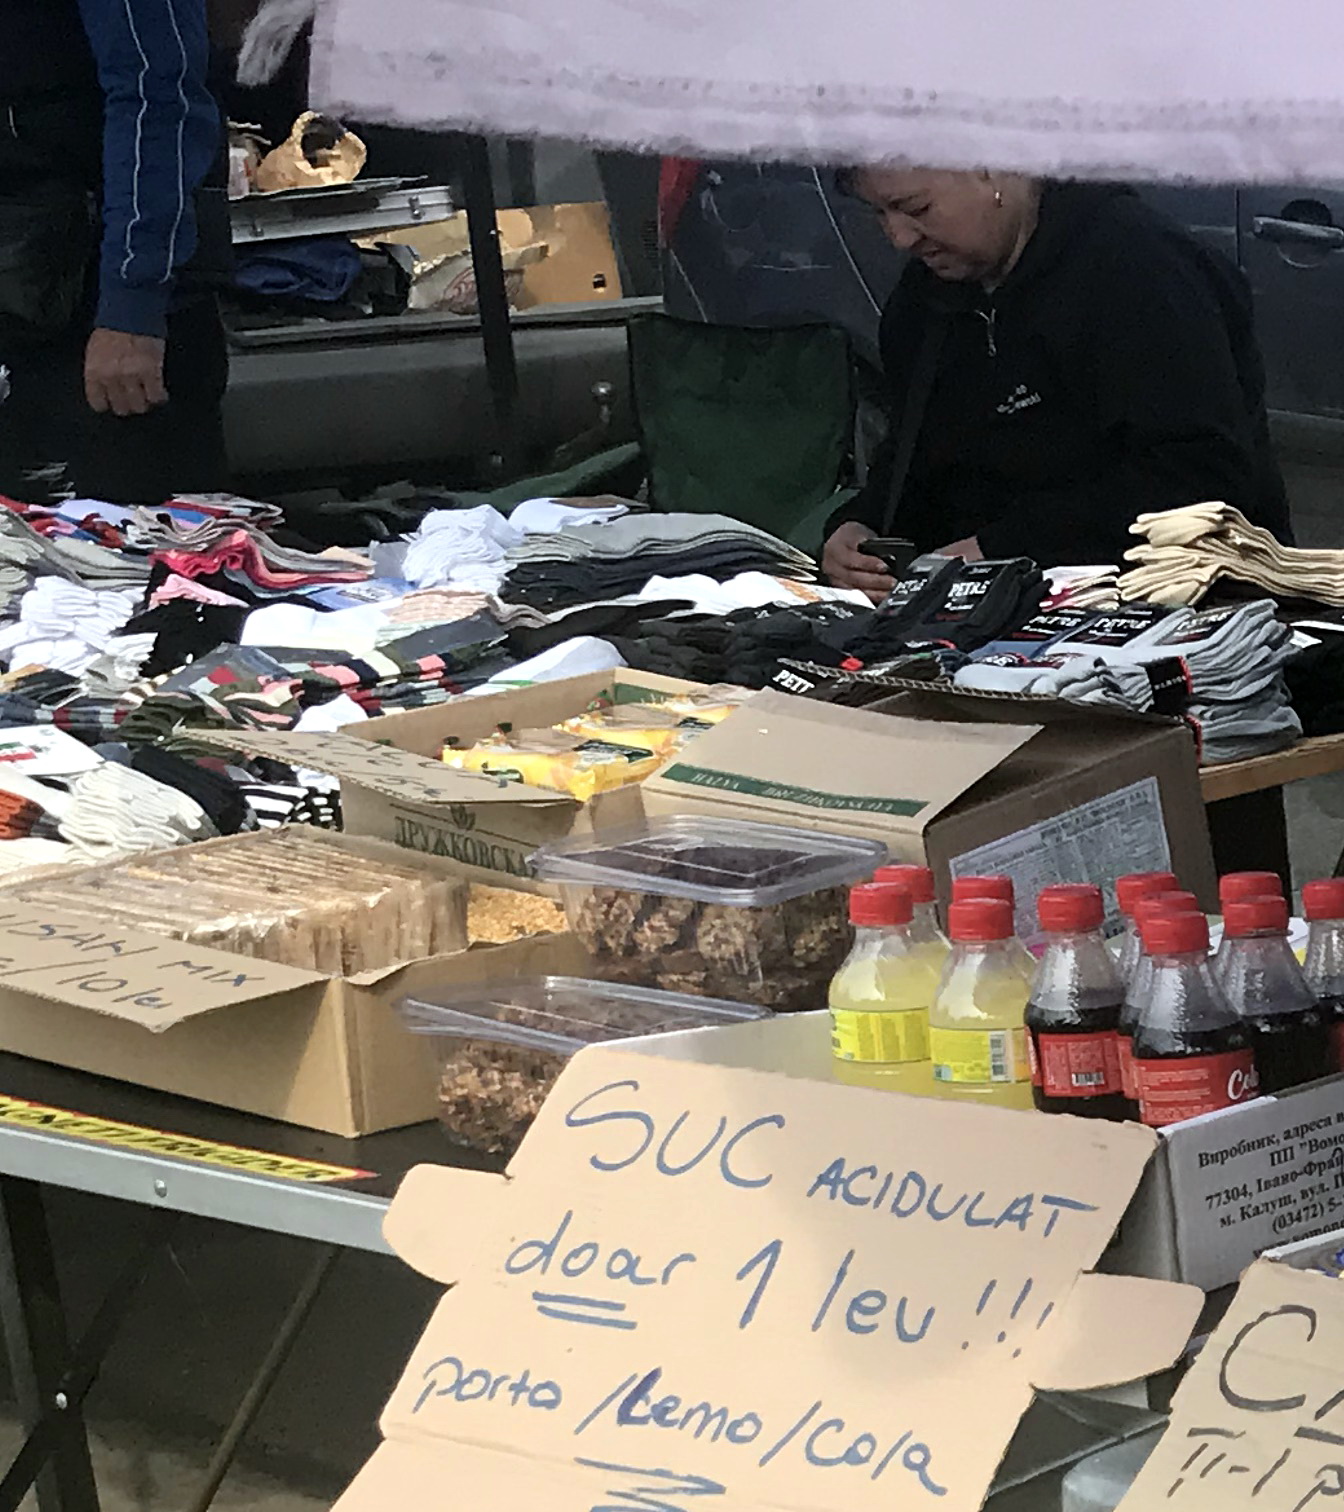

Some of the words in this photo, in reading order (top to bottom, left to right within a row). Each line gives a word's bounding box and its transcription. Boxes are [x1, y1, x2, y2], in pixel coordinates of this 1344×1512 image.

[564, 1079, 786, 1190] SUC
[806, 1158, 1101, 1238] ACIDULAT
[1197, 1134, 1281, 1168] Виробник,
[1282, 1116, 1333, 1142] адреса
[504, 1210, 698, 1288] doar
[735, 1240, 784, 1329] 1
[811, 1248, 937, 1347] leu
